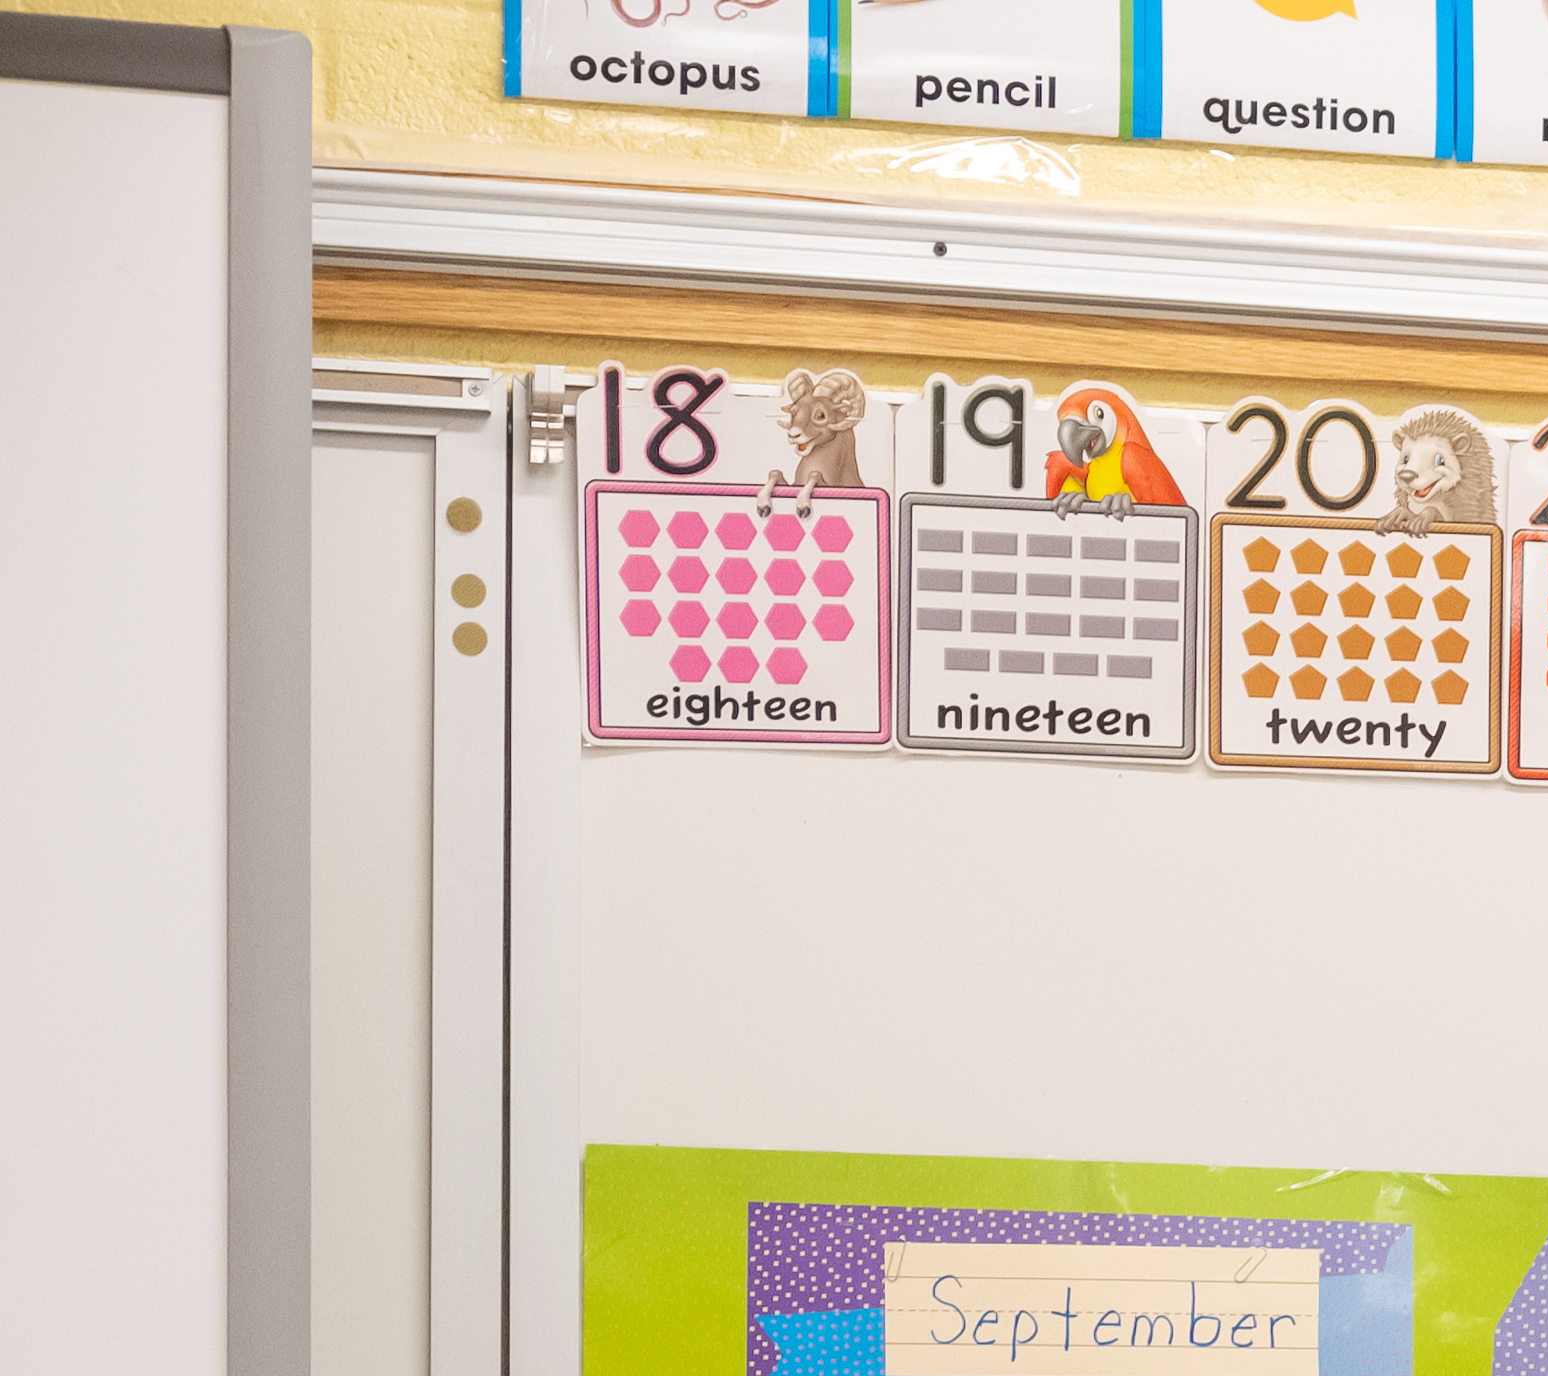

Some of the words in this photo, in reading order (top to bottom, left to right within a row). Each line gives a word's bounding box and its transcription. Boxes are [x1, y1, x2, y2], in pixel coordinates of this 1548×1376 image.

[569, 50, 761, 96] octopus
[915, 75, 1057, 109] pencil
[1203, 97, 1396, 135] question
[605, 368, 725, 476] 18
[932, 383, 1025, 490] 19
[1226, 407, 1378, 511] 20
[645, 684, 838, 727] eighteen
[937, 692, 1151, 738] nineteen
[1265, 707, 1448, 759] twenty
[929, 1273, 1297, 1363] September
